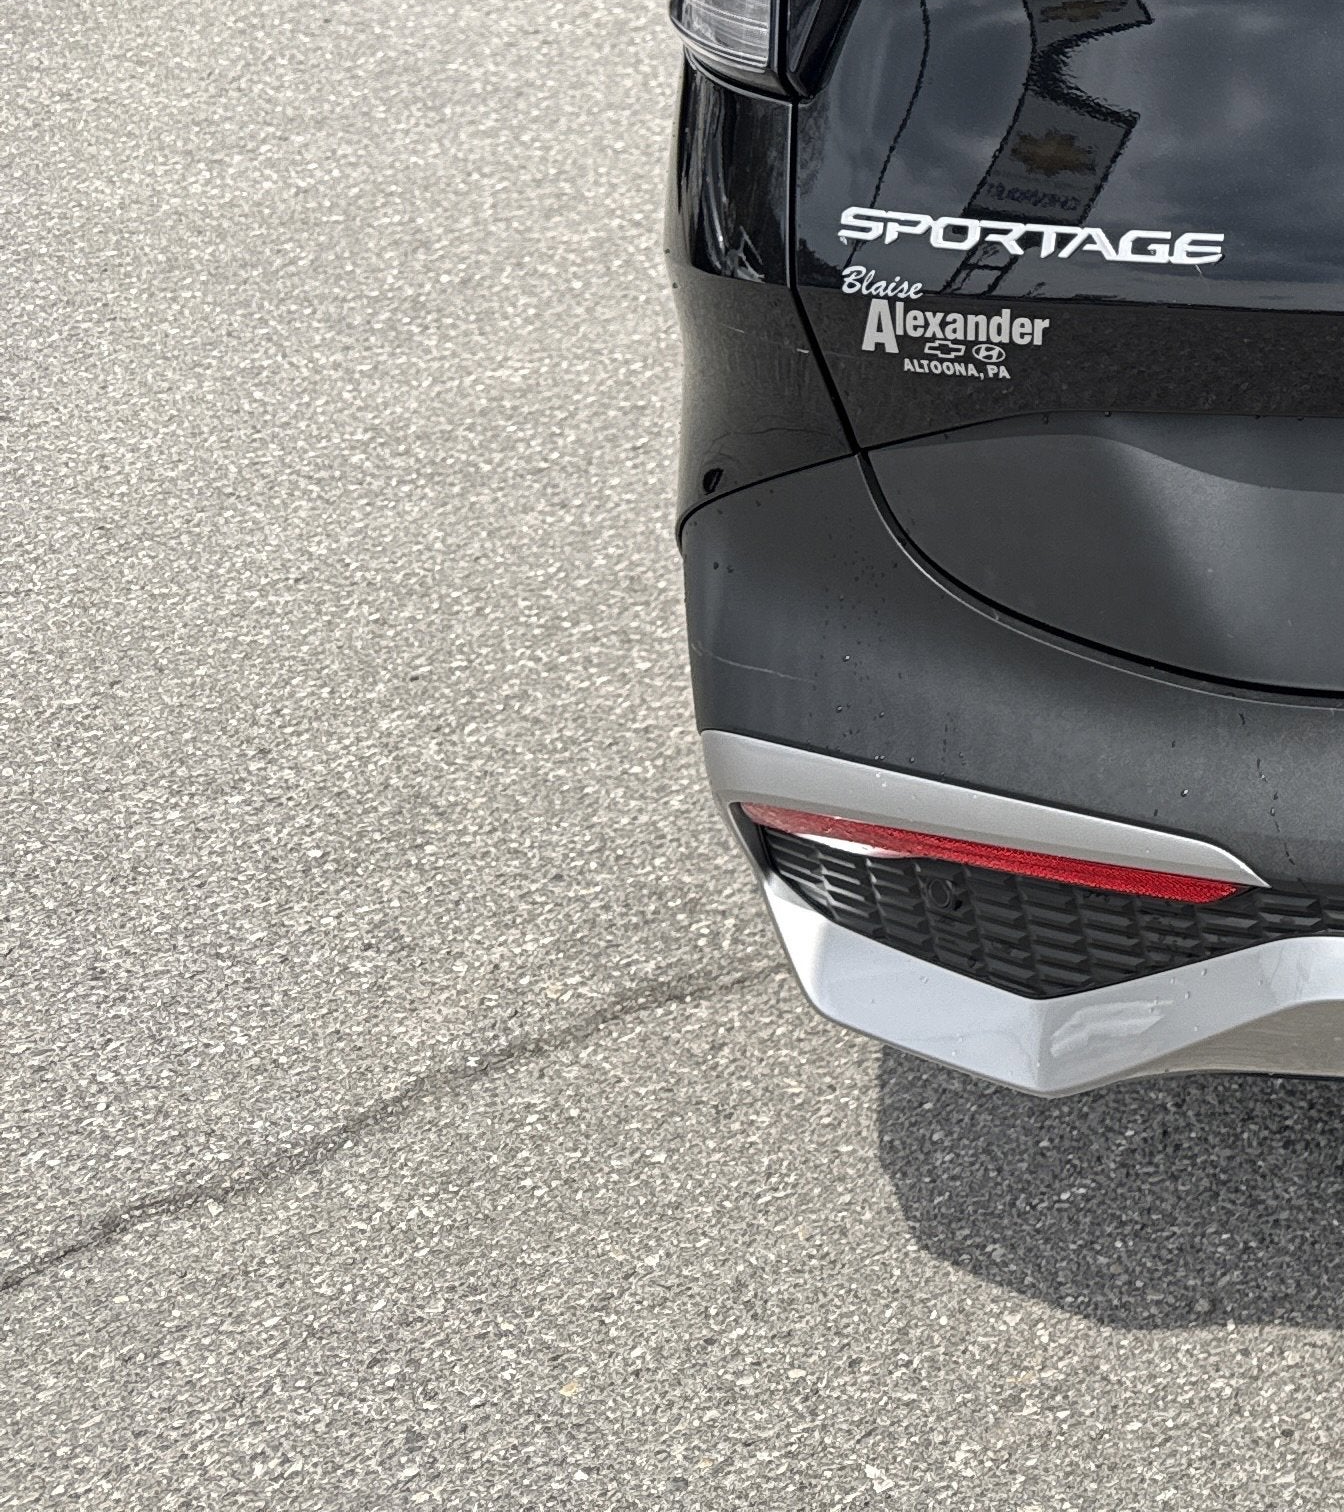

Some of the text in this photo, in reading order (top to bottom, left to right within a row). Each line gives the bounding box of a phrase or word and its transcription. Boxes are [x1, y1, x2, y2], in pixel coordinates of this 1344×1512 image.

[837, 206, 1226, 265] SPORTAGE
[841, 265, 924, 299] Blaise
[861, 298, 1050, 354] Alexander
[903, 358, 1011, 381] ALTOONA, PA
